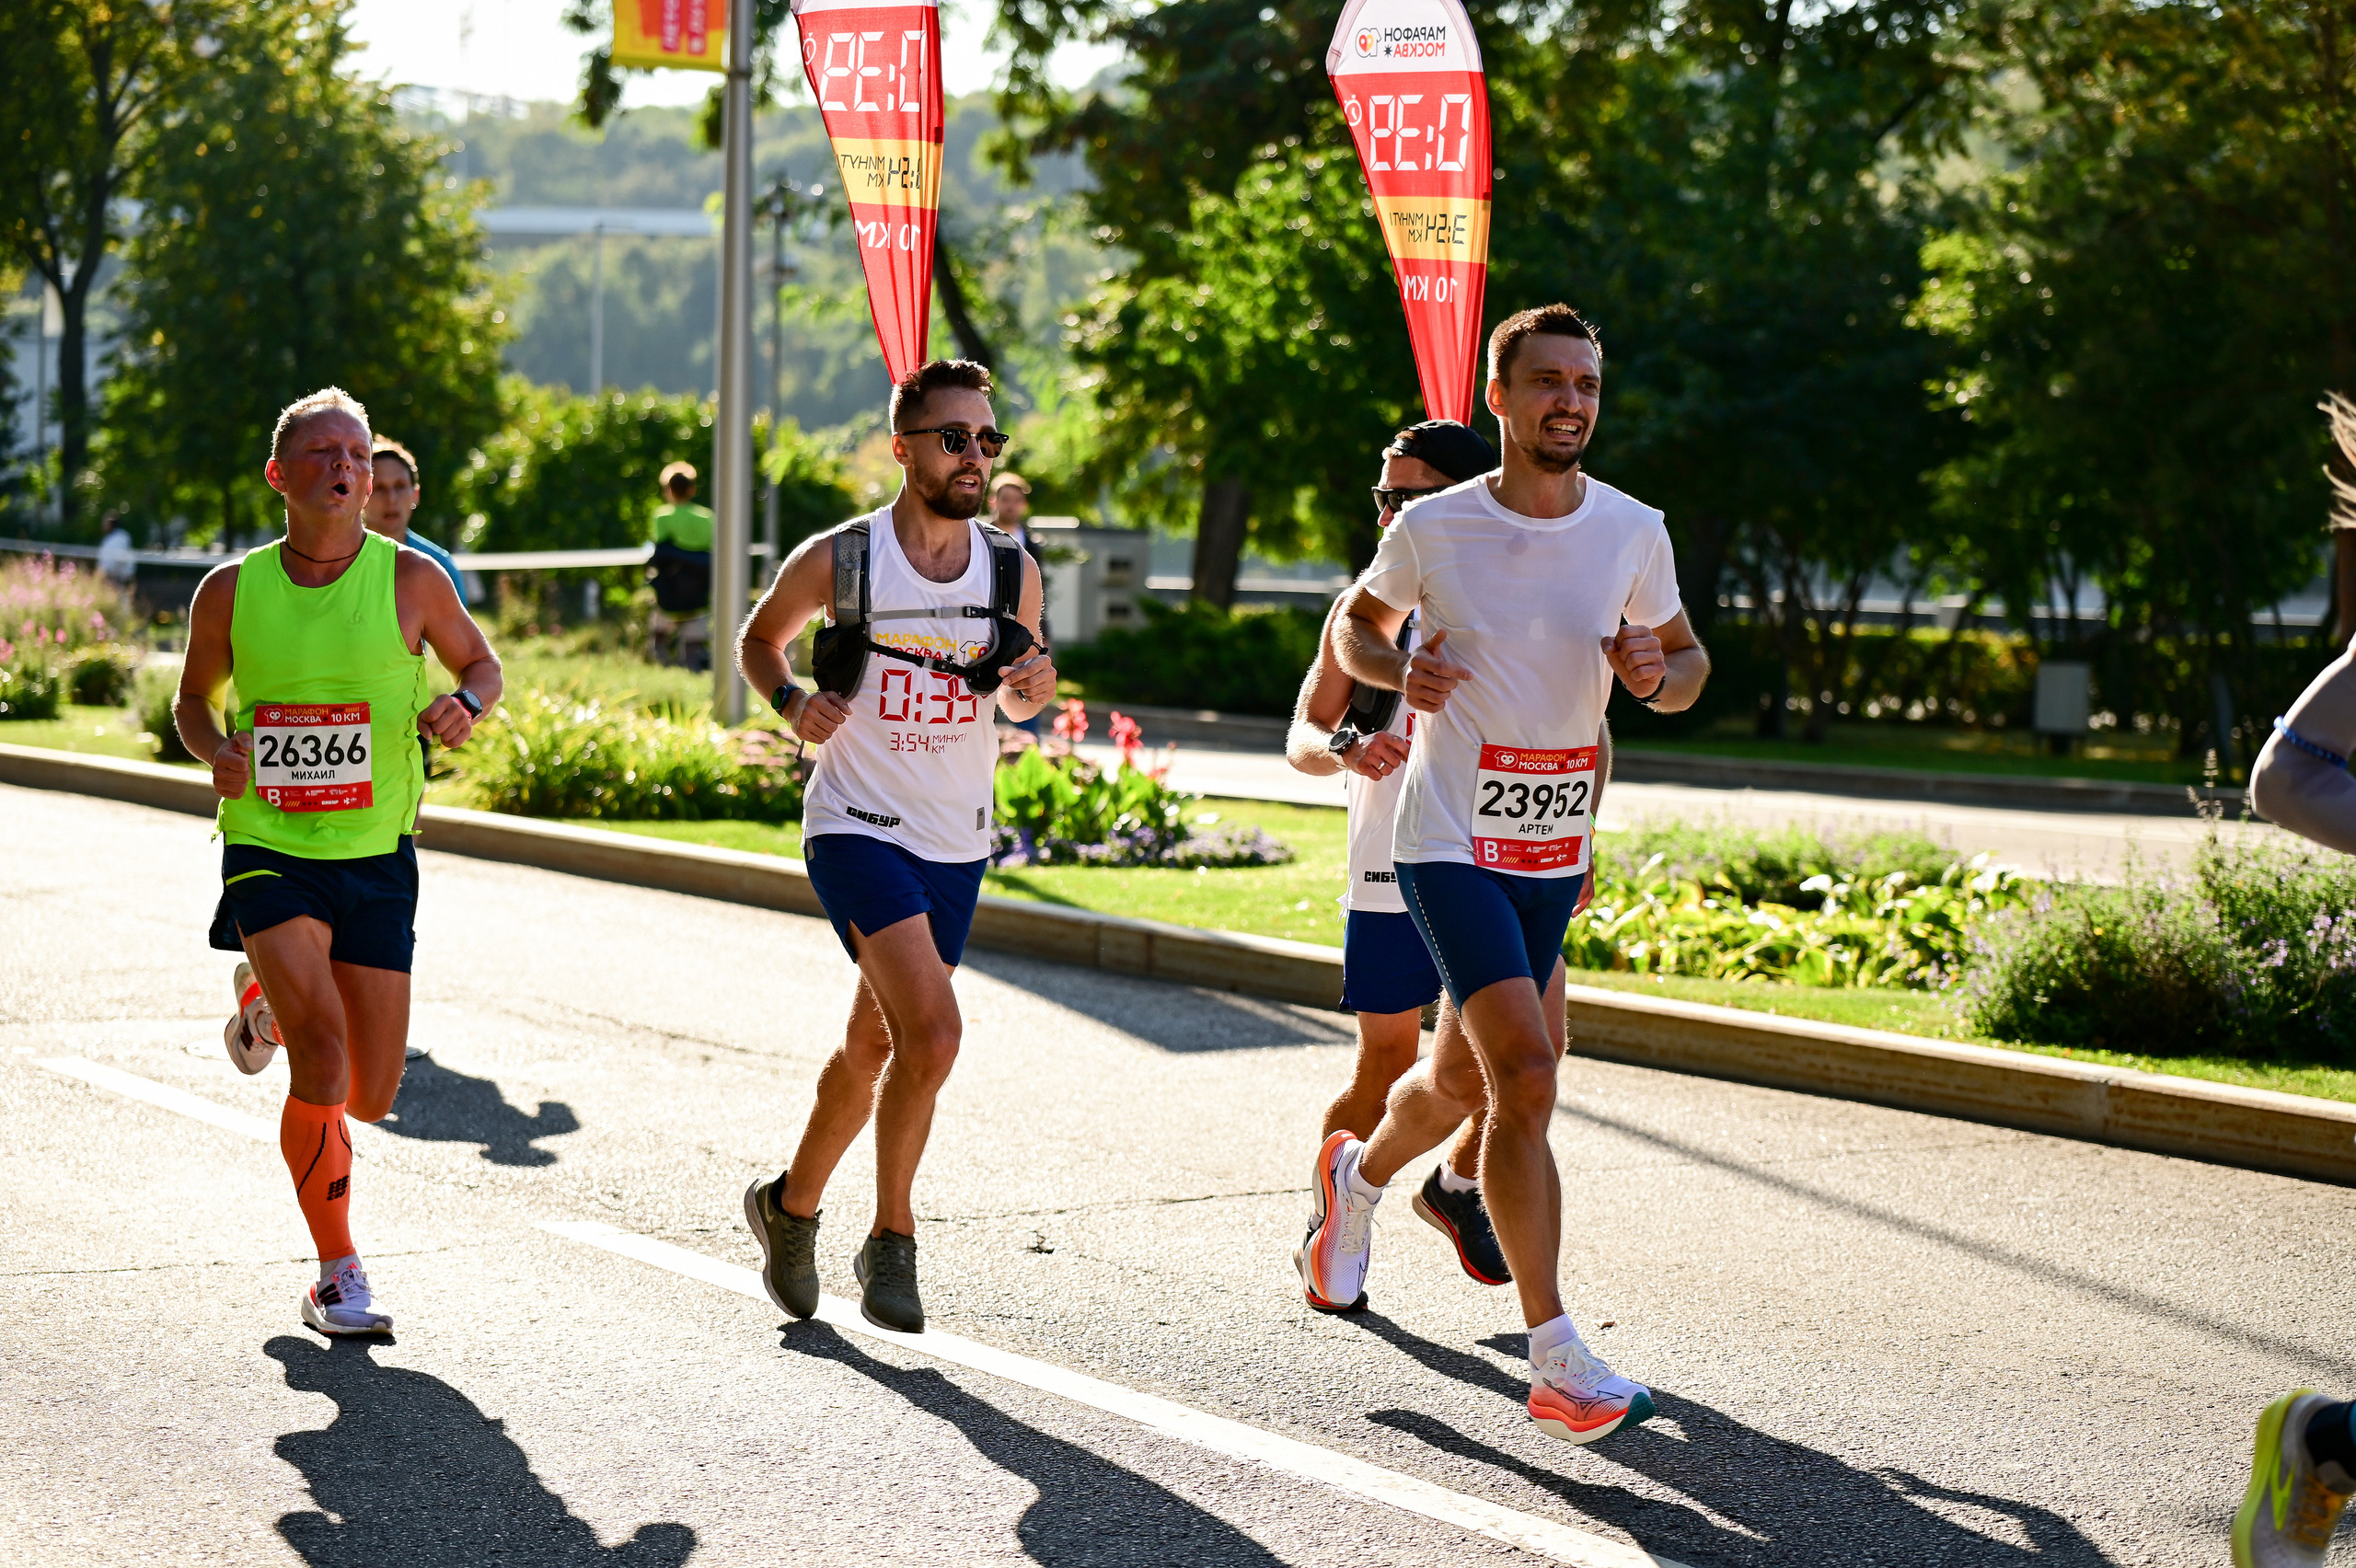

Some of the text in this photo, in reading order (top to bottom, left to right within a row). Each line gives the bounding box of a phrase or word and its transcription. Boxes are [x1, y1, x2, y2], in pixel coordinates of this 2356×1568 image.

[876, 633, 957, 651] МАРАФОН
[285, 712, 360, 723] МОСКВА 10 КМ
[259, 732, 366, 767] 26366
[890, 732, 930, 752] 3:54
[931, 745, 945, 755] КМ
[1520, 753, 1565, 762] МАРАФОН
[1519, 757, 1588, 770] МОСКВА 10 КМ
[292, 770, 335, 780] МИХАИЛ
[1479, 780, 1588, 821] 23952
[846, 806, 900, 828] СИБУР
